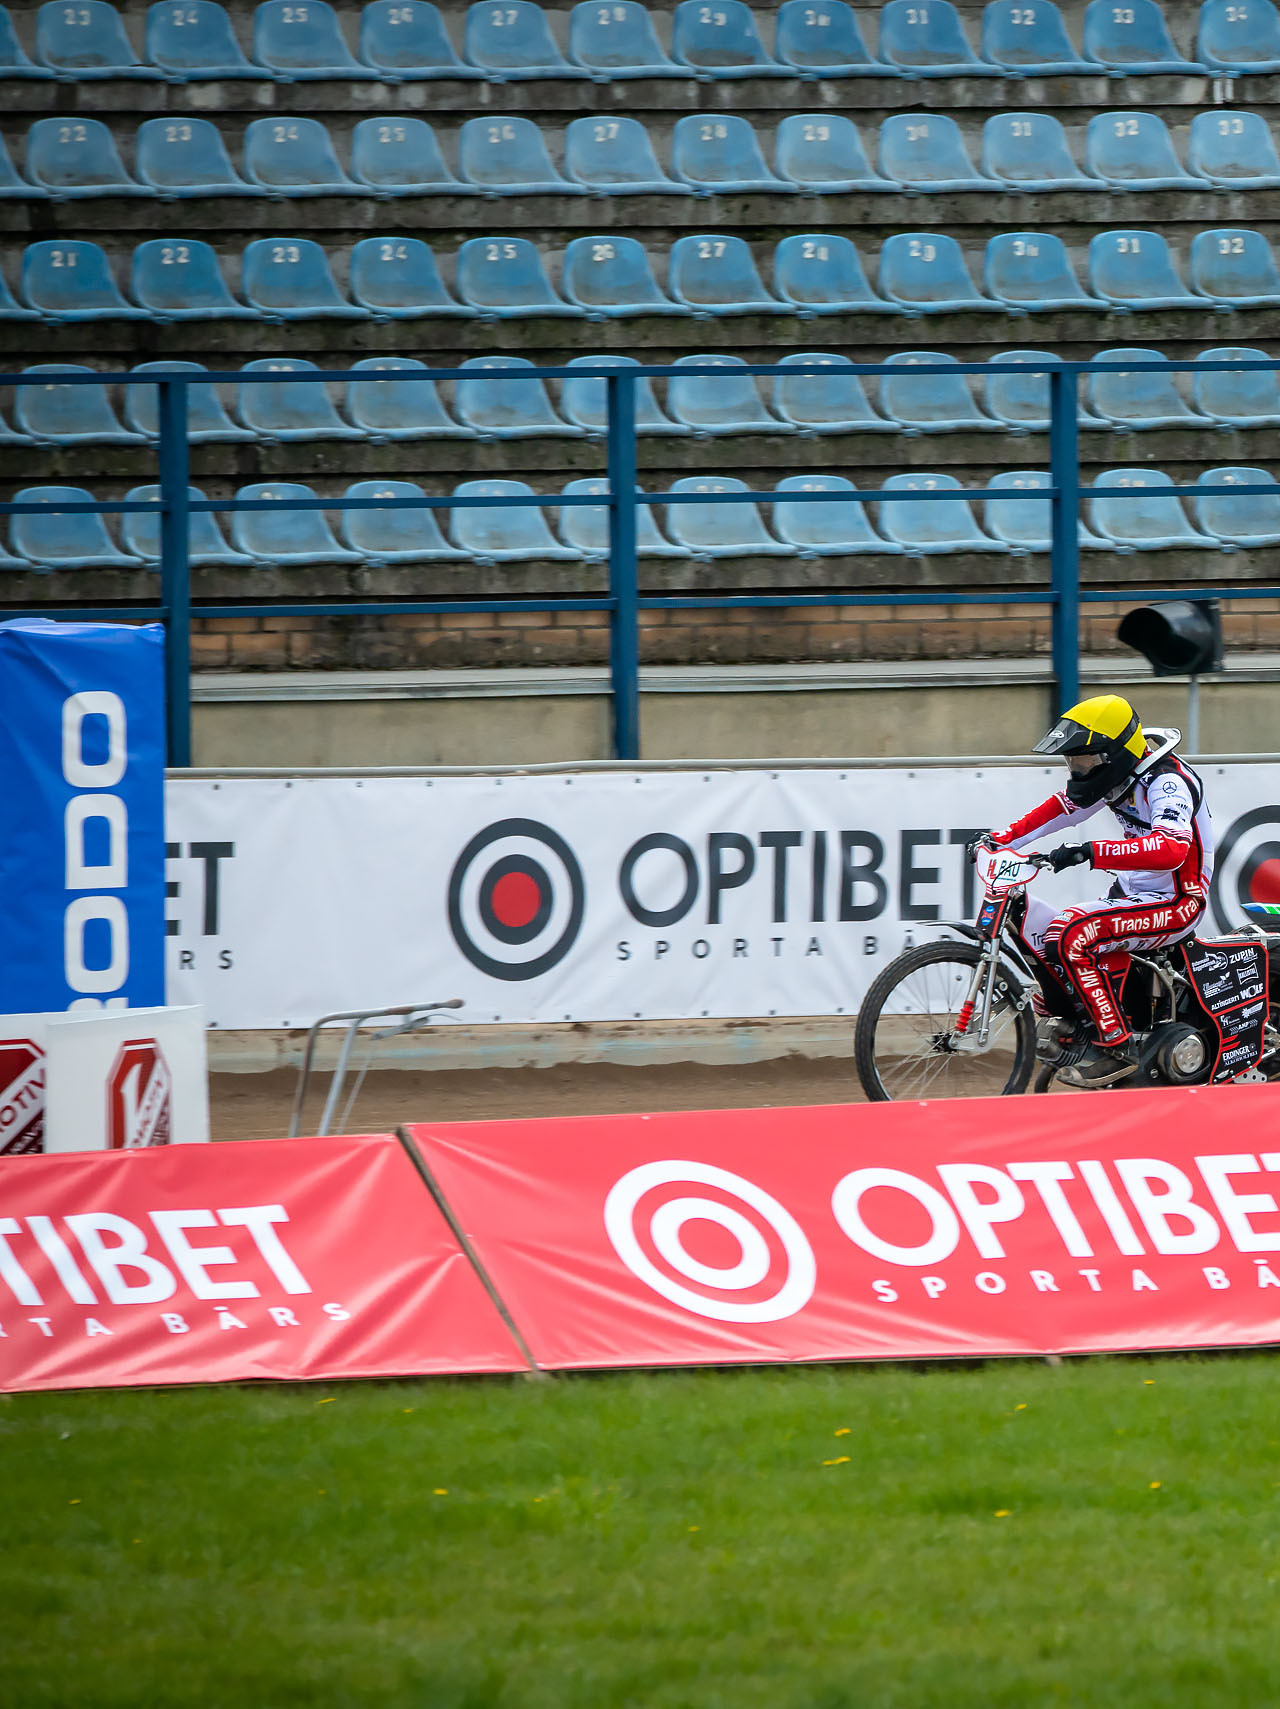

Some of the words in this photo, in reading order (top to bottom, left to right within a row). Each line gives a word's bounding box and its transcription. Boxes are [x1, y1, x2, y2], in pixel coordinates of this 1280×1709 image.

[63, 8, 91, 26] 23
[173, 9, 198, 27] 24
[282, 7, 308, 24] 25
[388, 7, 413, 25] 26
[491, 9, 519, 27] 27
[597, 6, 626, 25] 28
[699, 7, 727, 26] 29
[905, 8, 929, 25] 31
[1010, 8, 1035, 26] 32
[1112, 8, 1135, 24] 33
[1225, 6, 1249, 22] 34
[59, 125, 87, 143] 22
[165, 125, 192, 143] 23
[273, 126, 299, 143] 24
[378, 126, 405, 143] 25
[488, 124, 515, 144] 26
[594, 122, 620, 143] 27
[802, 124, 830, 141] 29
[1010, 121, 1032, 137] 31
[1114, 119, 1139, 138] 32
[1218, 118, 1244, 136] 33
[272, 246, 300, 263] 23
[380, 244, 408, 261] 24
[487, 244, 517, 261] 25
[592, 243, 615, 262] 26
[698, 241, 726, 259] 27
[909, 240, 936, 262] 29
[1116, 237, 1141, 254] 31
[1218, 237, 1244, 255] 32
[51, 250, 76, 268] 21
[161, 246, 190, 265] 22
[61, 690, 130, 1013] ODO
[1096, 841, 1140, 857] Trans
[1143, 835, 1165, 852] MF
[618, 828, 988, 925] OPTIBET
[1176, 897, 1200, 922] Tra
[1111, 917, 1150, 934] Trans
[1152, 909, 1173, 930] MF
[1083, 920, 1102, 942] MF
[618, 937, 822, 961] SPORTA
[863, 928, 952, 956] BĀ
[1229, 948, 1255, 965] ZUPIN
[1077, 966, 1101, 989] MF
[1240, 983, 1264, 1000] WOLF
[1091, 988, 1116, 1030] Trans
[1222, 1045, 1250, 1062] ERDINGER
[872, 1269, 1160, 1304] SPORTA
[160, 1303, 351, 1336] BĀRS
